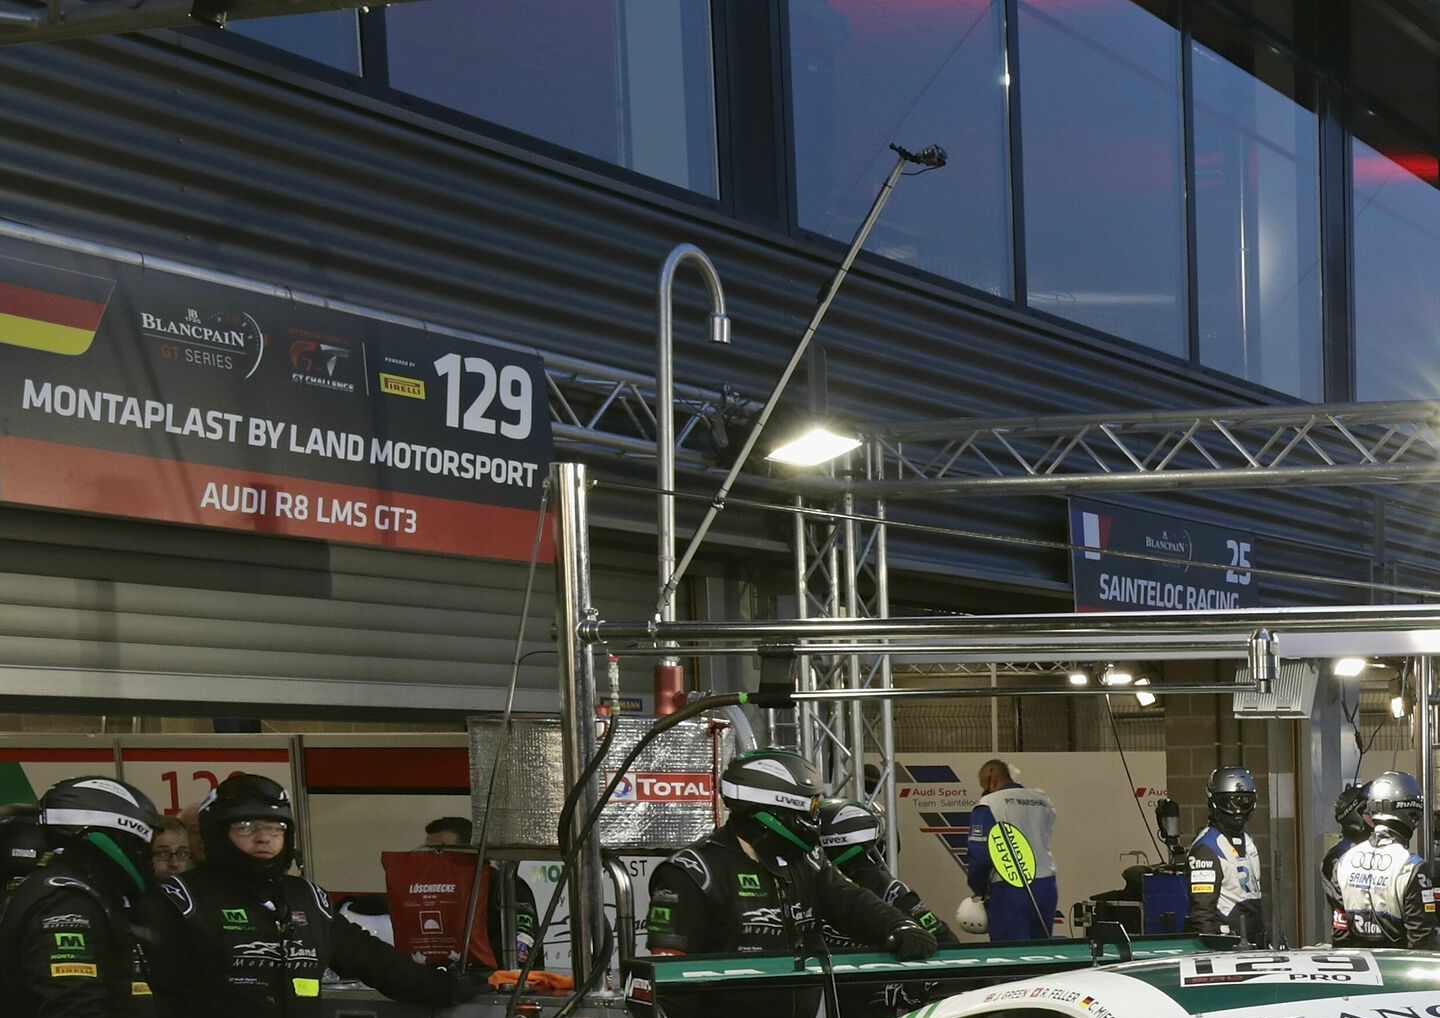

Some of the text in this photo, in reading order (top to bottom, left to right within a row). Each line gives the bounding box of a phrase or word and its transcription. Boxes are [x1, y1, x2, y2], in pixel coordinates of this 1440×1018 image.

[160, 345, 234, 370] GT SERIES
[383, 376, 422, 396] PIRELLI
[433, 352, 533, 440] 129
[22, 379, 538, 488] MONTAPLAST BY LAND MOTORSPORT
[200, 481, 418, 534] AUDI R8 LMS GT3
[1145, 536, 1185, 553] BLANCPAIN
[1225, 539, 1252, 586] 25
[1099, 573, 1240, 610] SAINTELOC RACING
[161, 770, 248, 816] 12
[637, 777, 712, 797] TOTAL
[912, 787, 968, 799] Audi Sport
[774, 795, 807, 809] uvex
[913, 799, 937, 808] Team
[1004, 797, 1016, 806] PIT
[117, 817, 150, 838] uvex
[821, 835, 848, 846] uvex
[993, 834, 1019, 882] START
[289, 946, 318, 958] Land
[1192, 954, 1370, 975] 129
[1288, 973, 1352, 982] PRO
[1040, 988, 1082, 1003] R.FELLER
